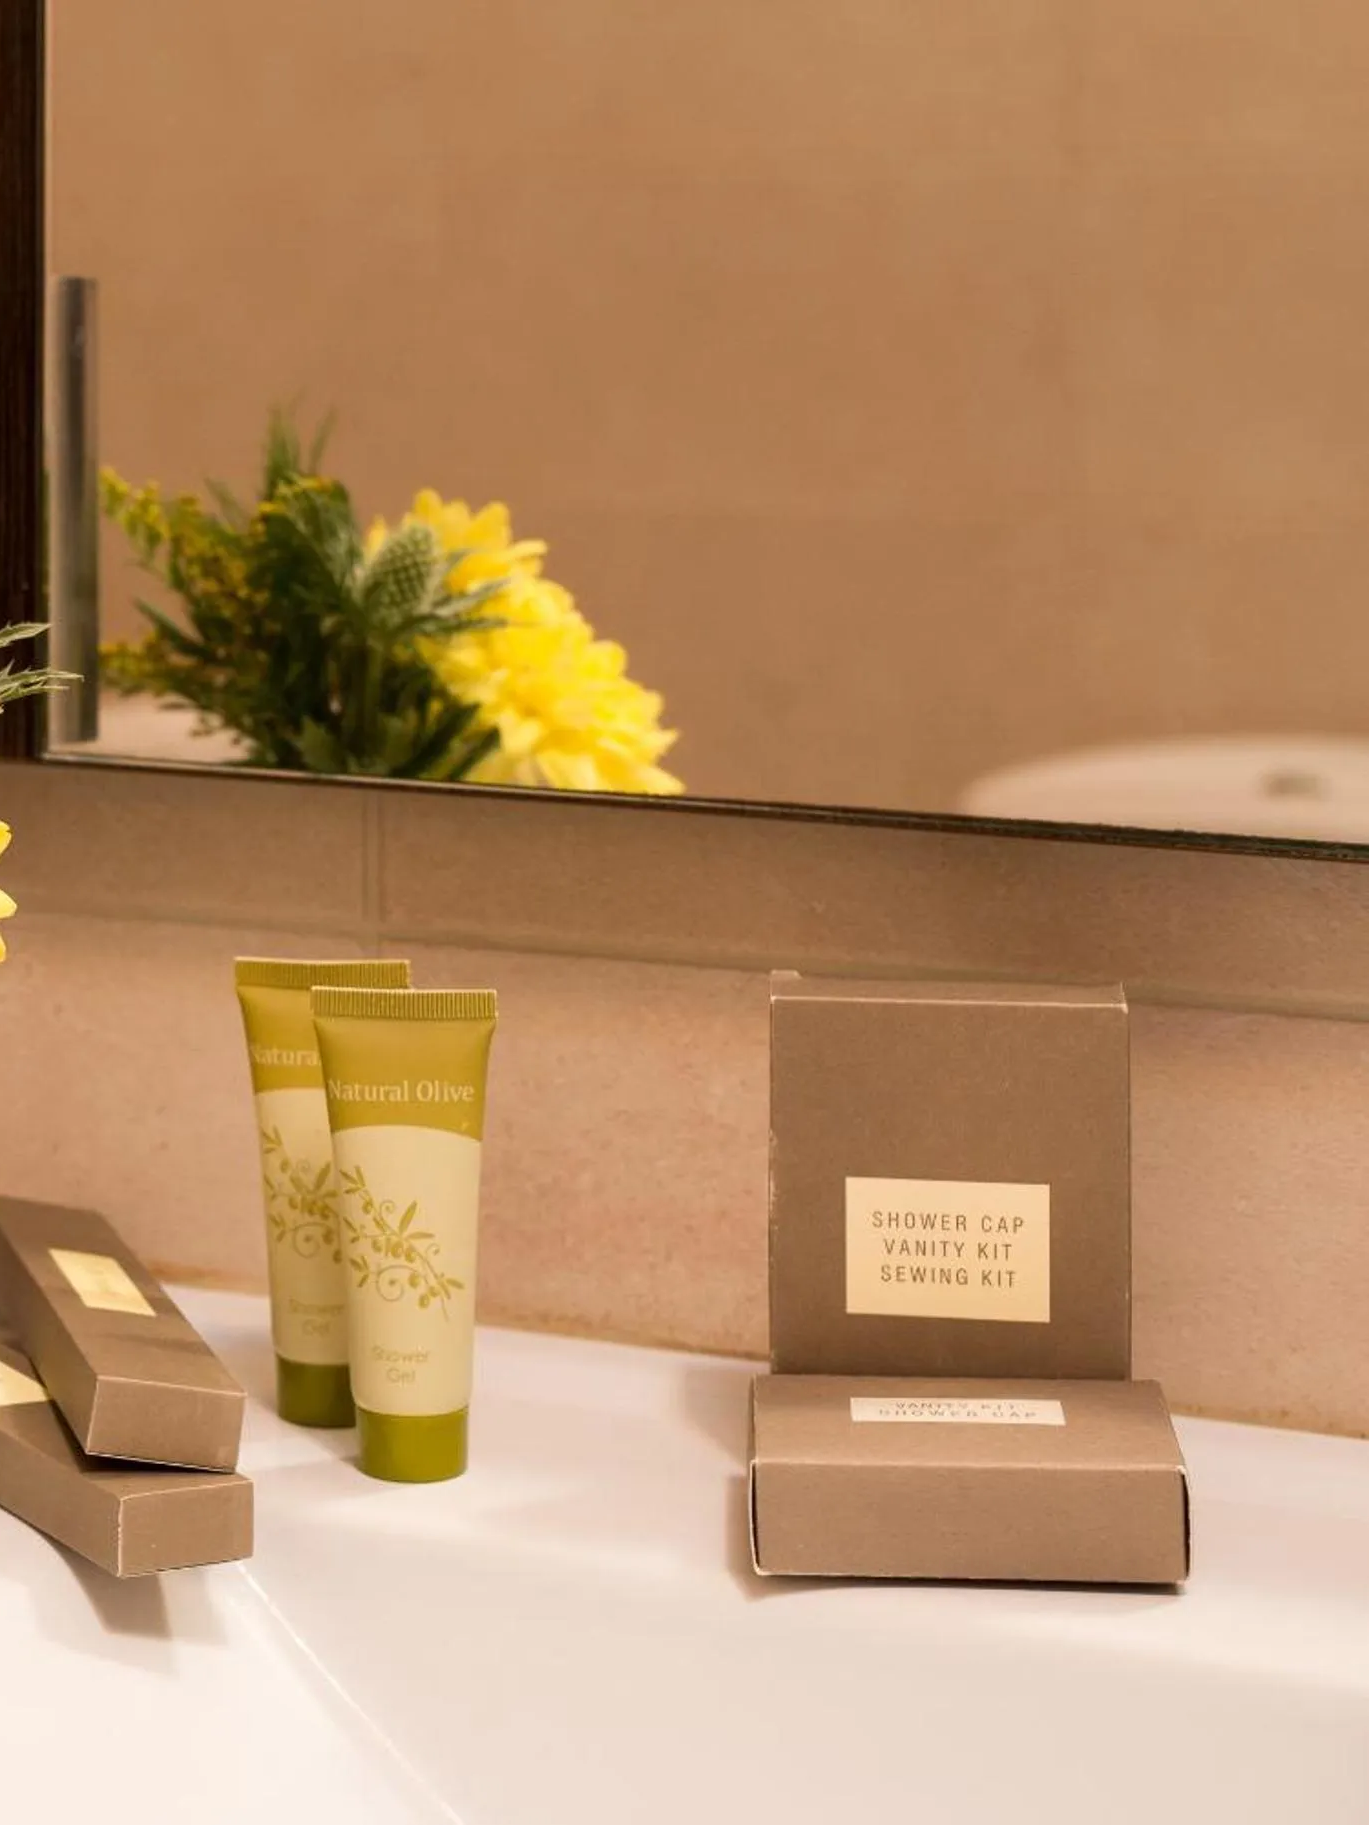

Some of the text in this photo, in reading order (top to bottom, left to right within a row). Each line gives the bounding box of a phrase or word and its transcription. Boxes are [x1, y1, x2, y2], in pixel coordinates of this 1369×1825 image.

[249, 1044, 322, 1067] Natura
[328, 1079, 475, 1102] Natural Olive
[871, 1210, 1024, 1233] SHOWER CAP
[883, 1238, 1013, 1261] VANITY KIT
[880, 1264, 1017, 1288] SEWING KIT
[386, 1367, 416, 1386] Gel
[896, 1401, 969, 1410] VANITY
